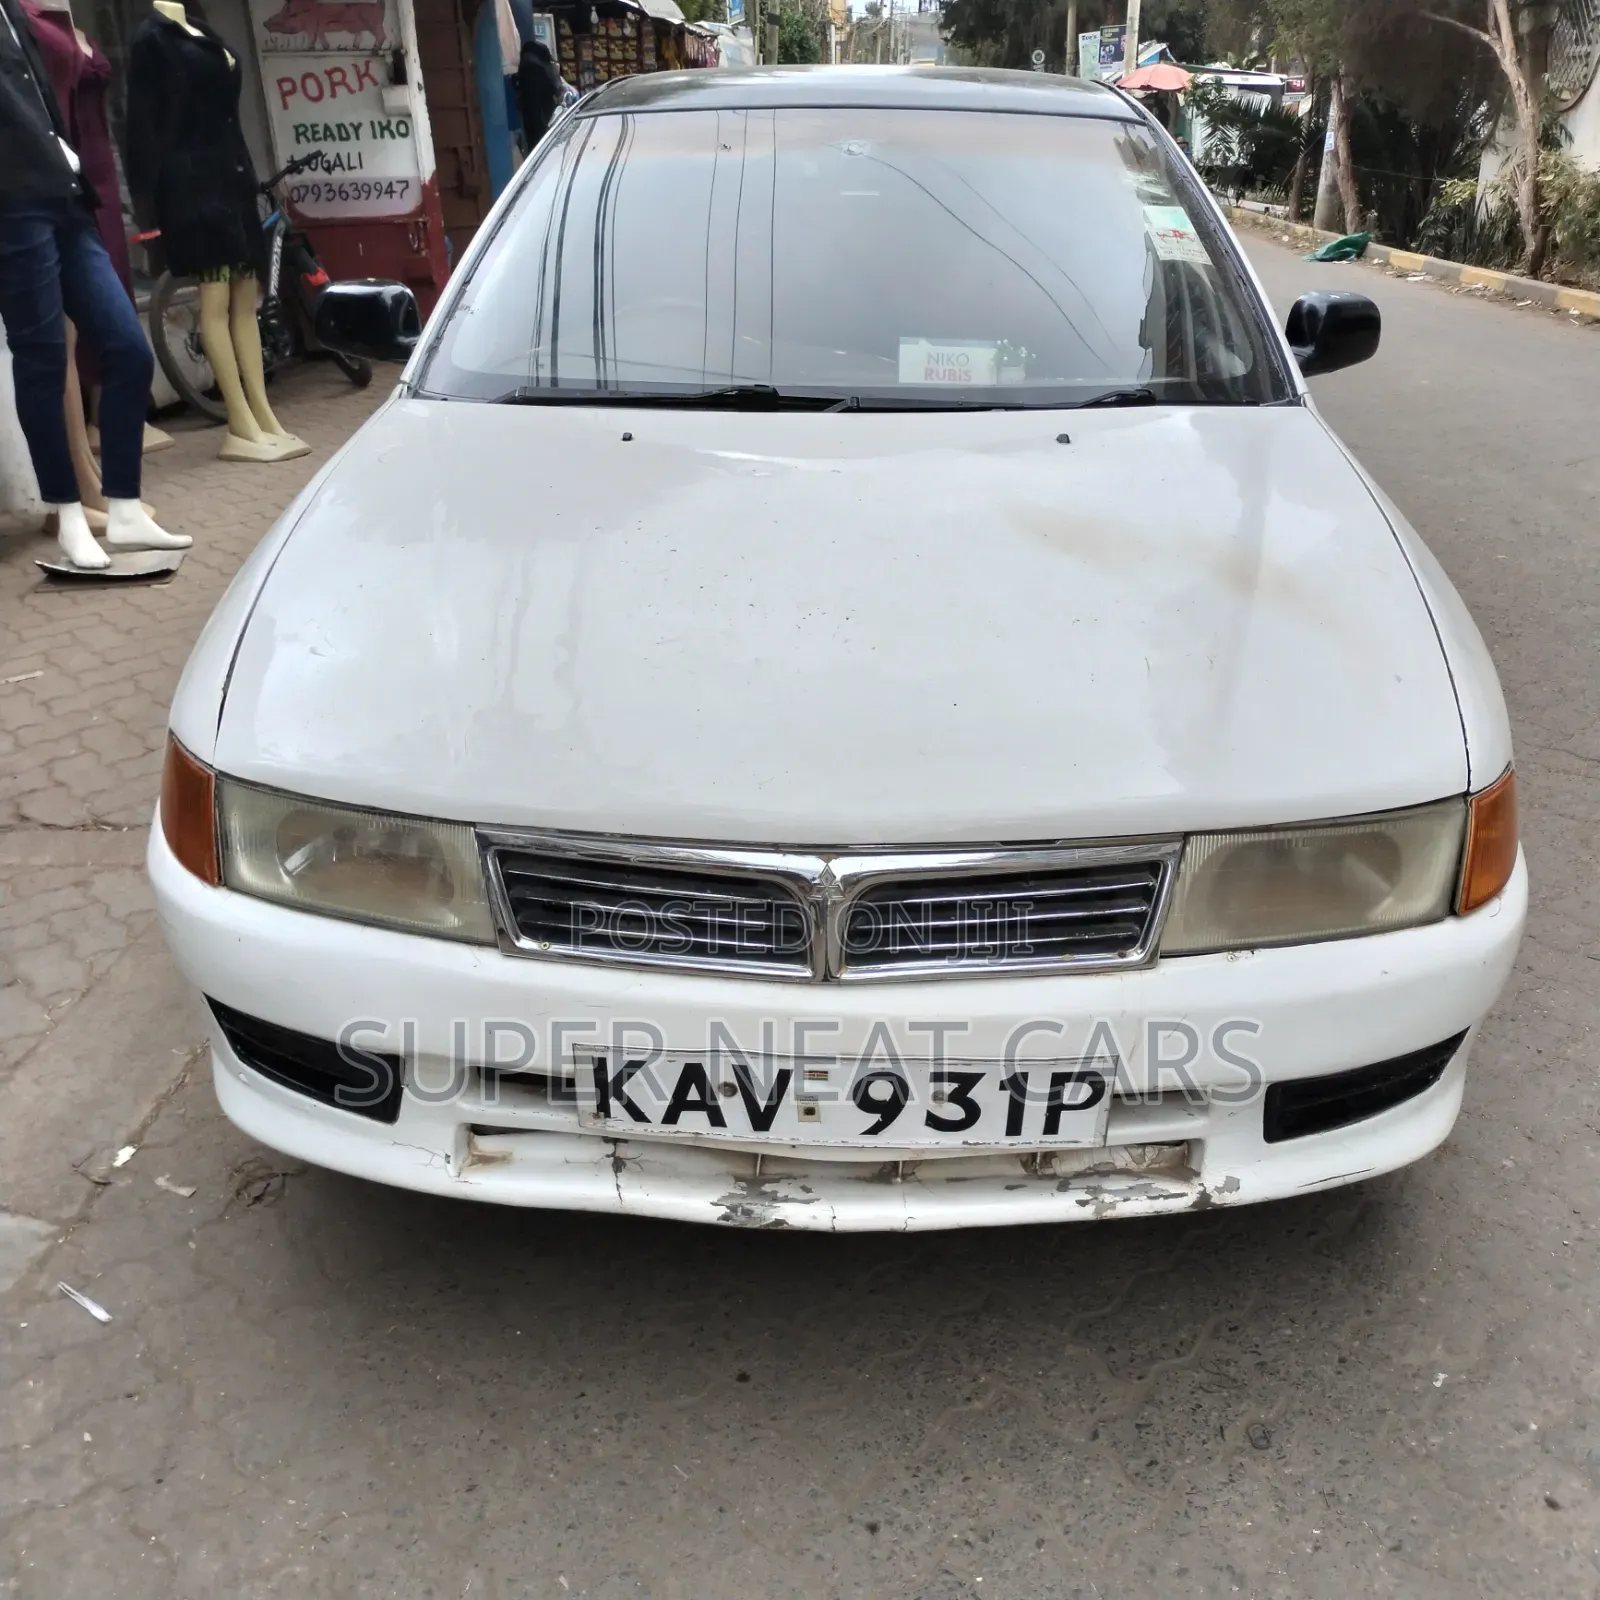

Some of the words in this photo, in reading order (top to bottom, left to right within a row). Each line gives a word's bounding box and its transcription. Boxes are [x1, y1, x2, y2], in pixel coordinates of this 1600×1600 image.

[276, 60, 379, 111] PORK
[293, 122, 363, 145] READY
[370, 119, 410, 140] IKO
[290, 180, 410, 204] 0793639947
[927, 352, 970, 367] NIKO
[591, 1056, 794, 1132] KAV
[852, 1071, 1108, 1137] 931P
